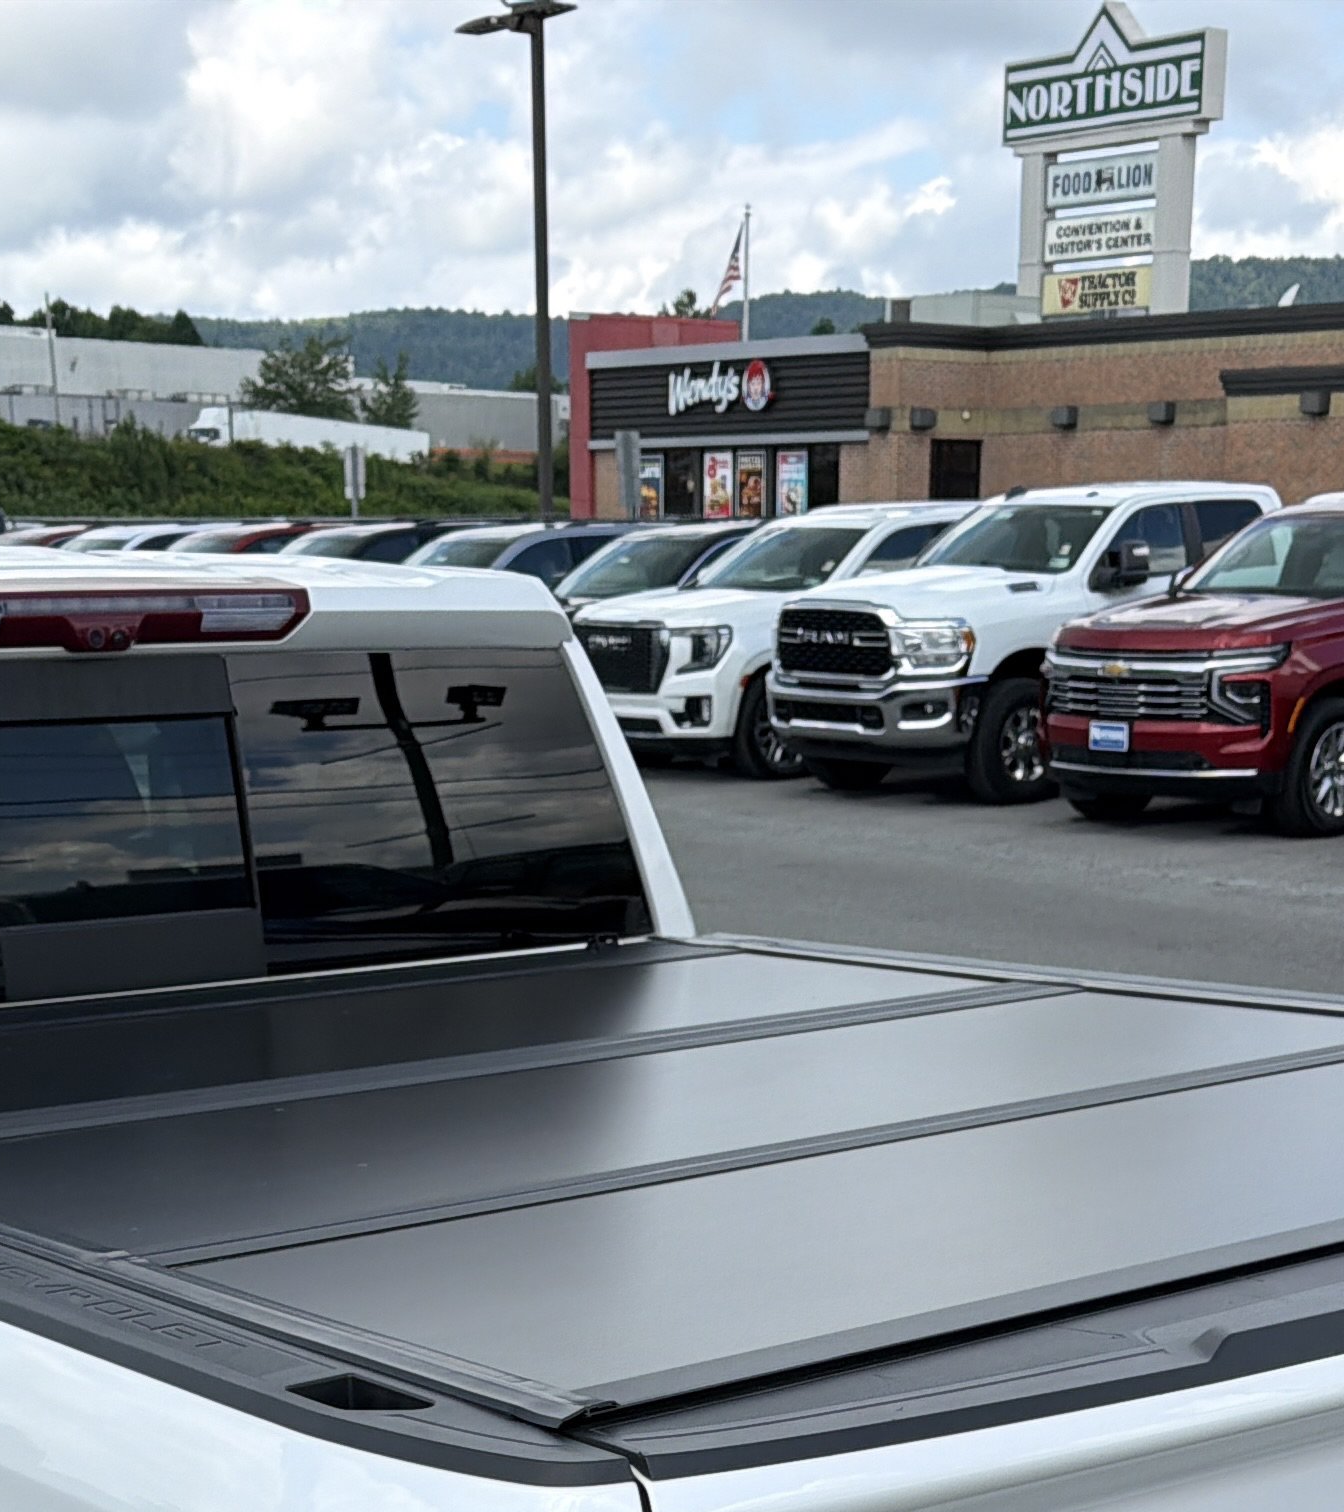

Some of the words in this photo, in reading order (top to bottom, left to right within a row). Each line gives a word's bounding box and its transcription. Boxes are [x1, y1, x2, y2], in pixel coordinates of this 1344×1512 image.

[1006, 59, 1201, 124] NORTHSIDE
[1052, 171, 1092, 198] FOOD
[1117, 163, 1153, 189] LION
[1056, 219, 1130, 239] CONVENTION
[1048, 237, 1103, 255] VISITOR'S
[1105, 233, 1152, 250] CENTER
[1080, 271, 1137, 291] TRACTOR
[1078, 290, 1120, 309] SUPPLY
[668, 361, 740, 416] Wendy's
